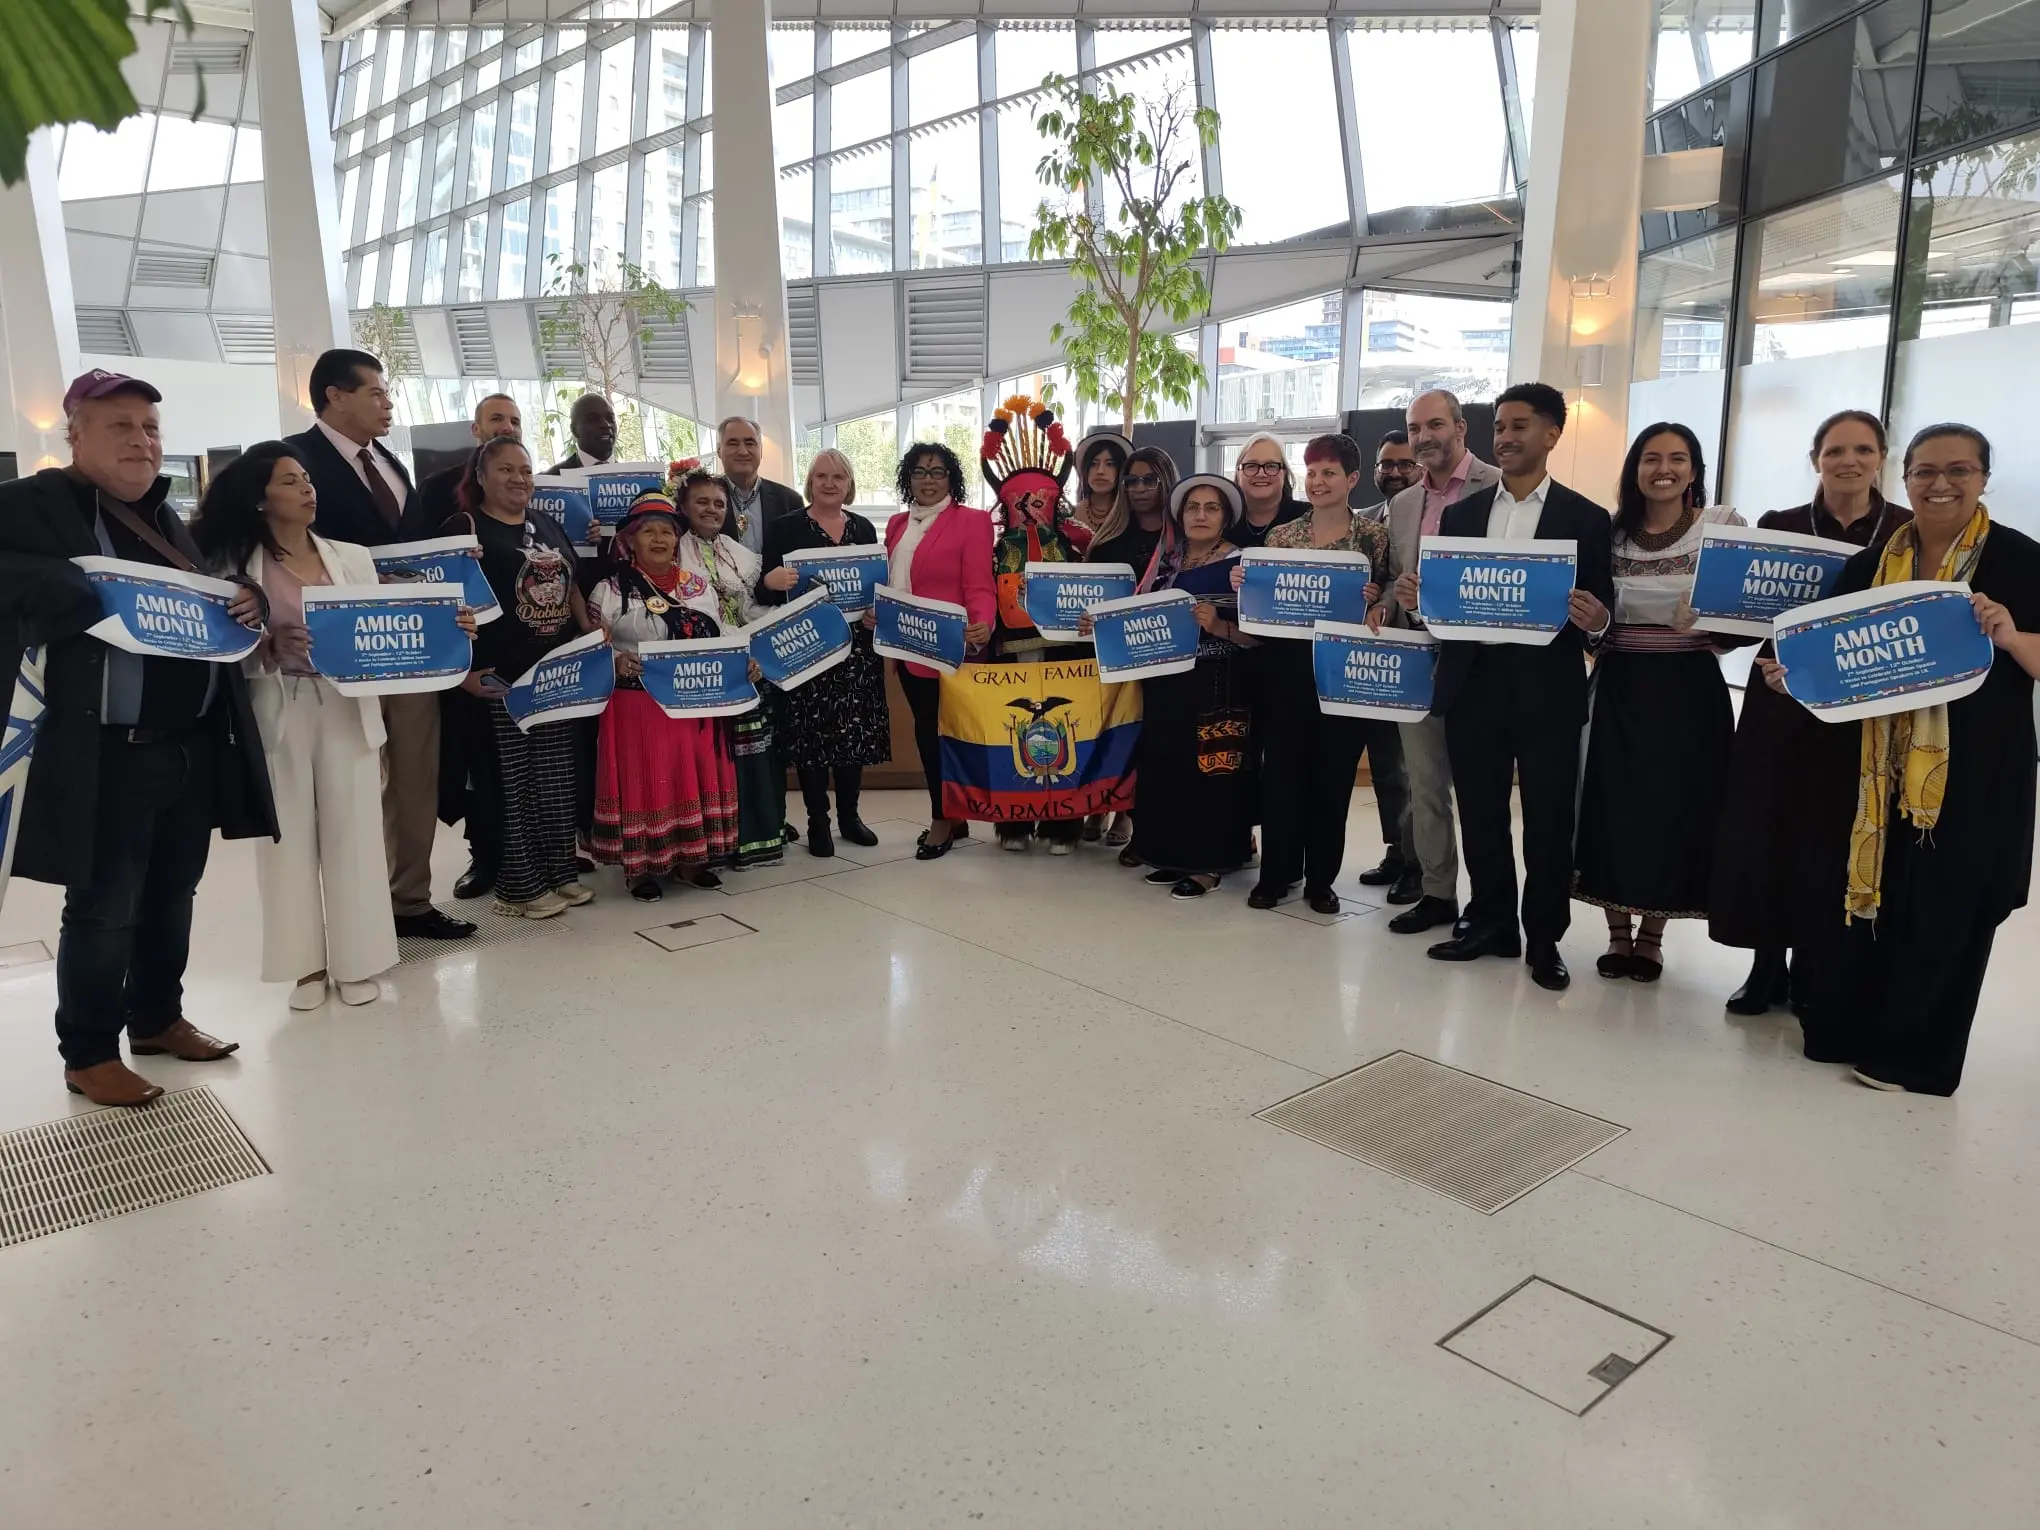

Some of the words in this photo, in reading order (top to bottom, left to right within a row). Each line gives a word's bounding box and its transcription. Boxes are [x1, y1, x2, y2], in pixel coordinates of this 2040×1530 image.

[598, 482, 640, 496] AMIGO
[528, 498, 566, 512] MIGO
[597, 496, 635, 508] MONT
[817, 566, 860, 580] AMIGO
[1460, 566, 1528, 585] AMIGO
[1746, 558, 1824, 583] AMIGO
[829, 580, 862, 594] ONTH
[1056, 583, 1104, 596] AMIGO
[1274, 572, 1331, 590] AMIGO
[1742, 578, 1821, 600] MONTH
[1274, 588, 1330, 604] MONTH
[1459, 584, 1526, 602] MONTH
[136, 592, 204, 620] AMIGO
[136, 612, 208, 640] MONTH
[354, 614, 424, 633] AMIGO
[897, 612, 937, 631] AMIGO
[1123, 614, 1168, 634] AMIGO
[354, 632, 425, 651] MONTH
[770, 618, 814, 648] AMIGO
[897, 624, 938, 644] MONTH
[1124, 628, 1172, 646] MONTH
[1834, 615, 1919, 654] AMIGO
[774, 628, 820, 658] MONTH
[1346, 650, 1402, 669] AMIGO
[1835, 635, 1927, 672] MONTH
[536, 661, 582, 684] AMIGO
[673, 660, 723, 677] AMIGO
[1344, 666, 1401, 684] MONTH
[532, 671, 580, 695] MONTH
[673, 674, 723, 690] MONTH
[973, 671, 1028, 686] GRAN
[966, 797, 1074, 819] WARMIS
